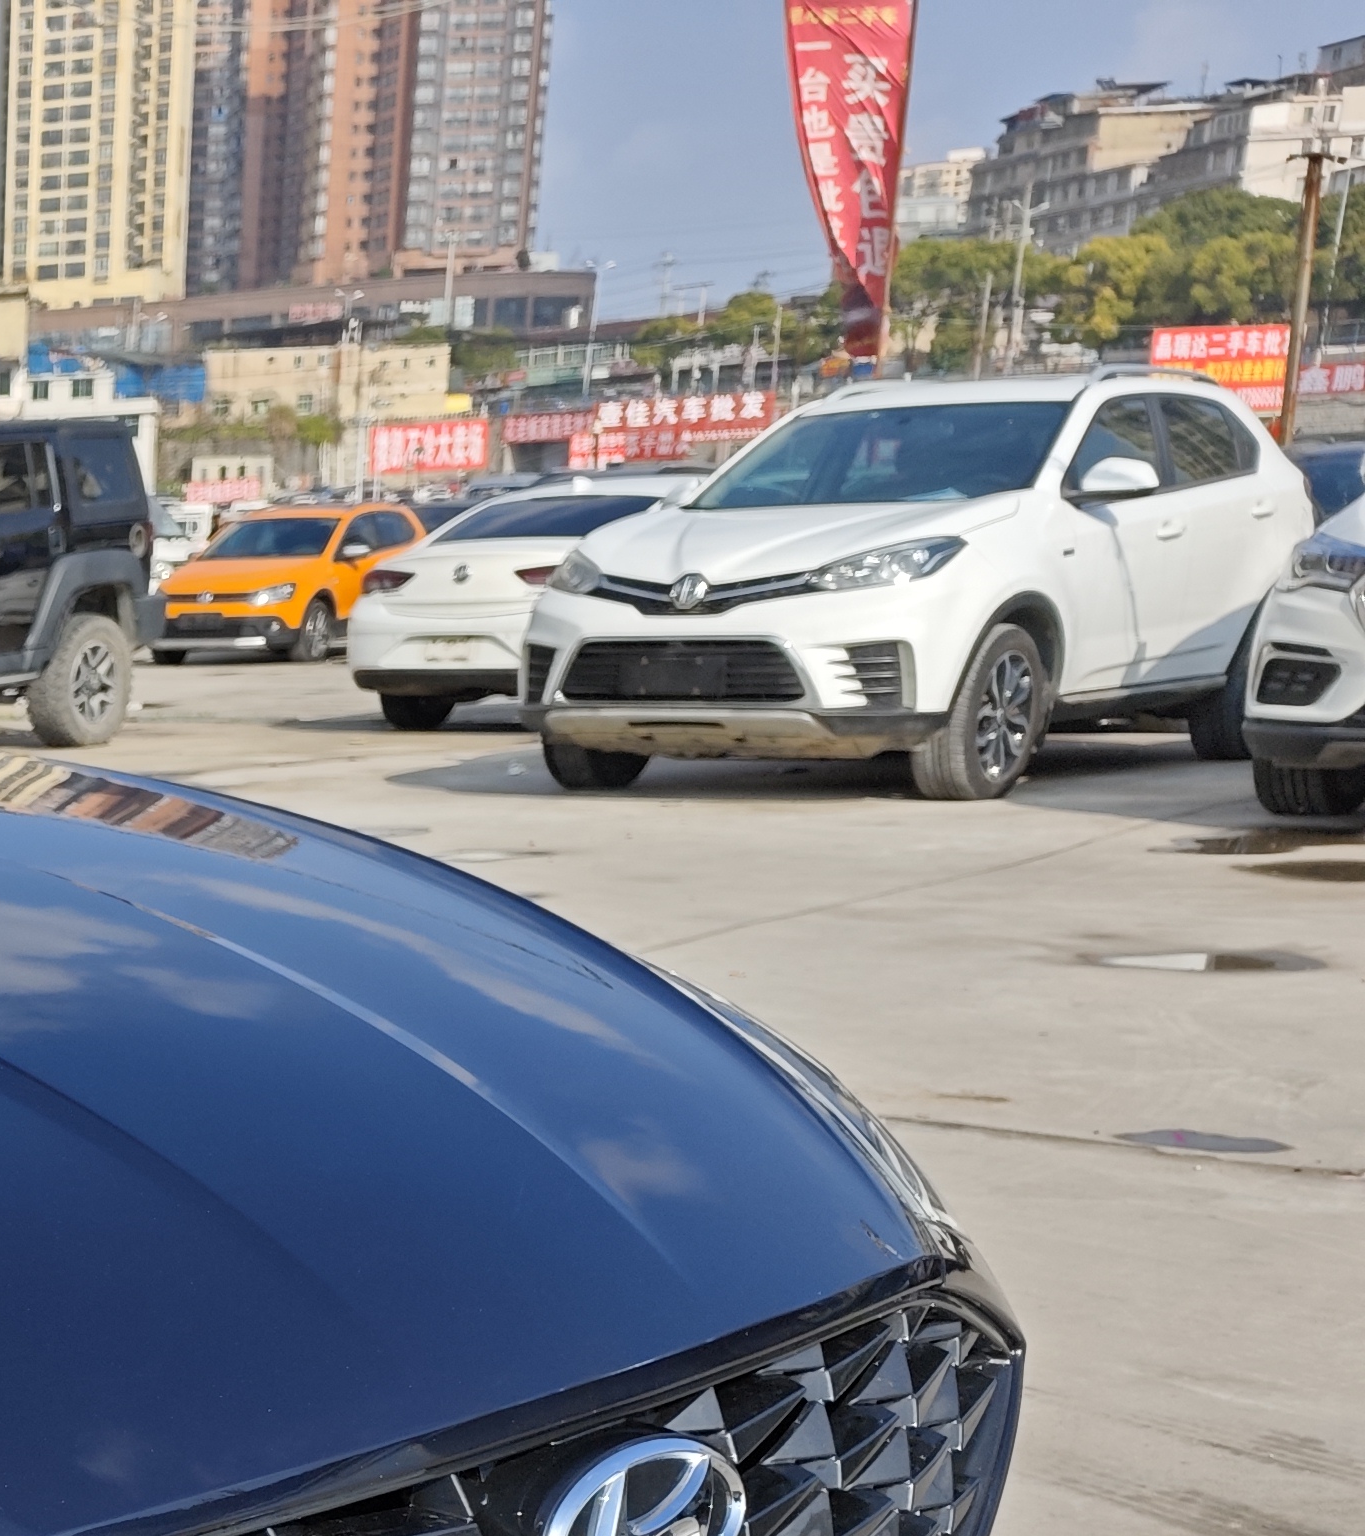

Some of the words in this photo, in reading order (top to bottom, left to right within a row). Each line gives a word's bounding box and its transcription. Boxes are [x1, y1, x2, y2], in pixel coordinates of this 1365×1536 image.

[597, 390, 766, 428] 壹佳汽车批发
